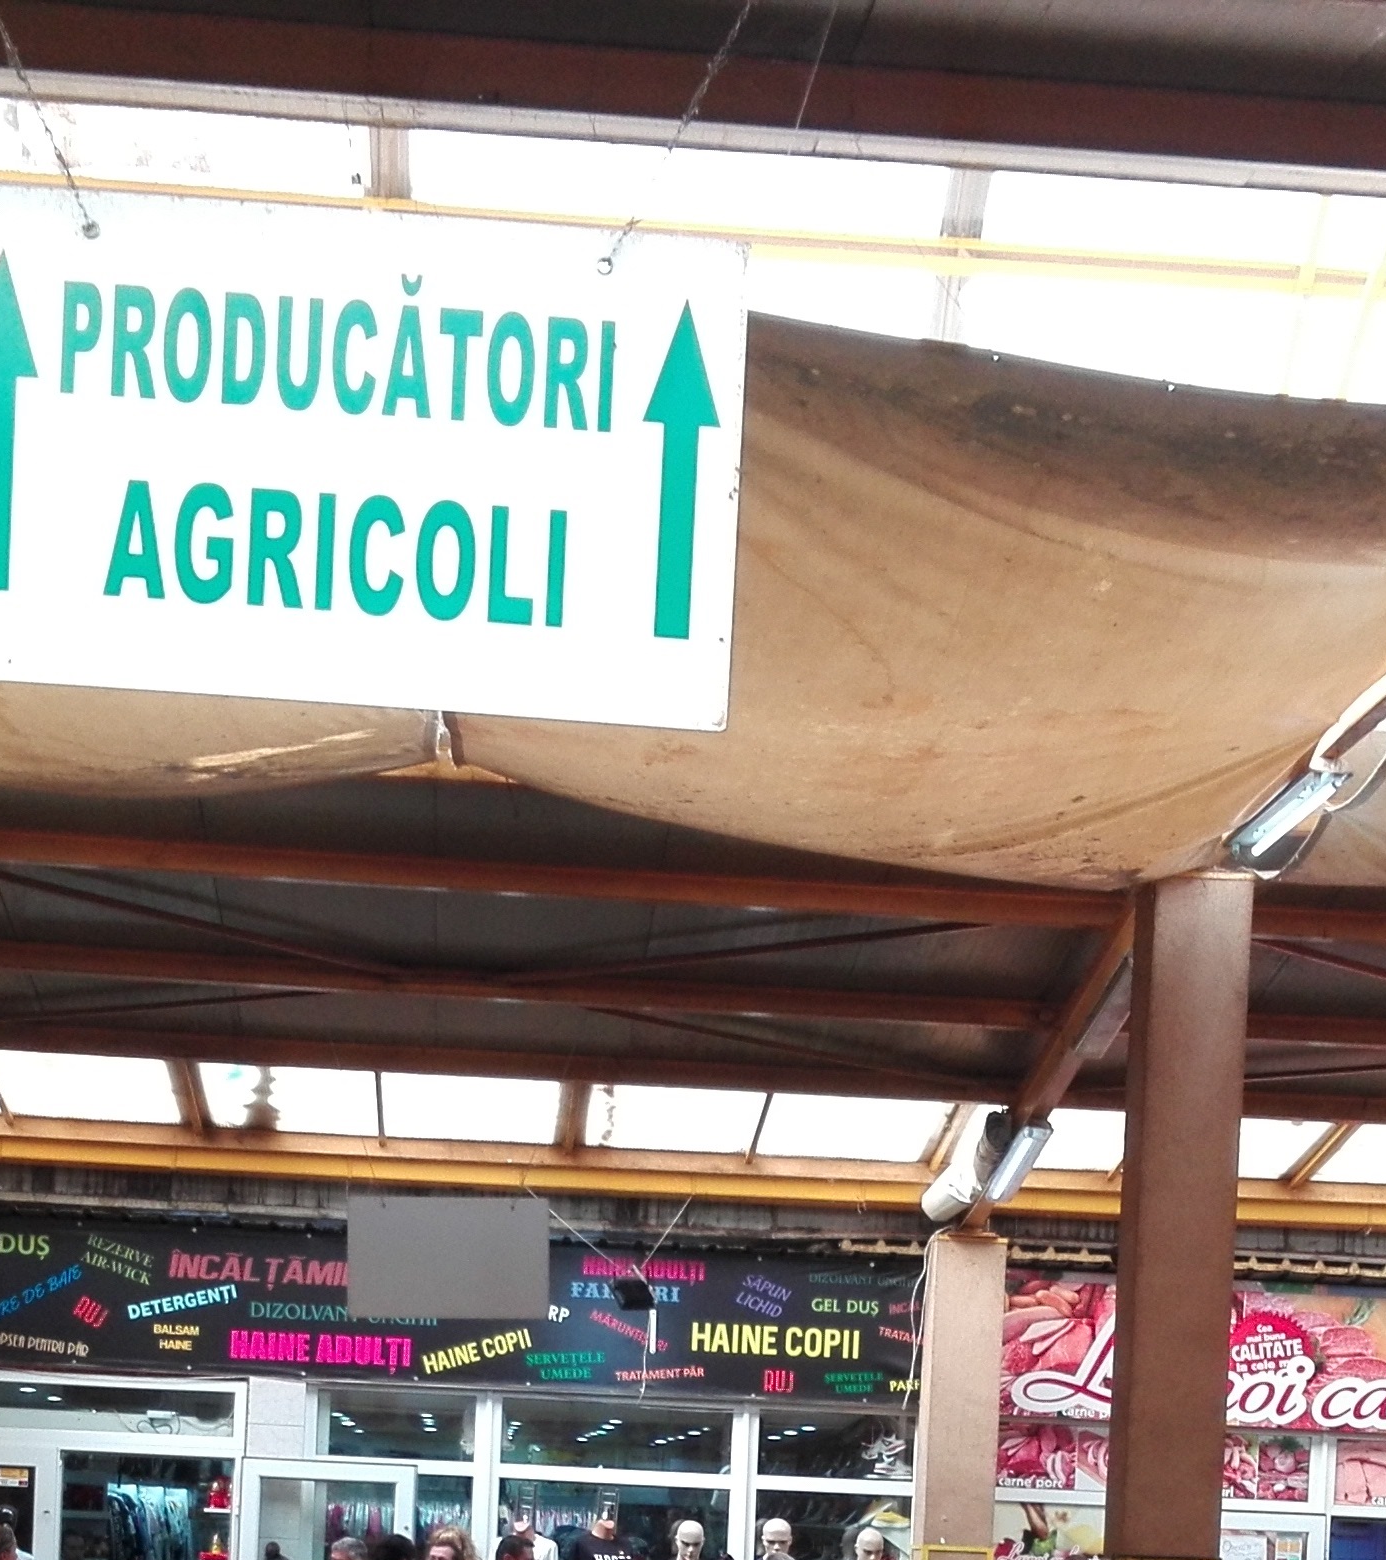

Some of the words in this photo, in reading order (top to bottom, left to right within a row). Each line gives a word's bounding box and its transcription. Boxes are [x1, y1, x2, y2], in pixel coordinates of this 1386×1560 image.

[59, 273, 616, 433] PRODUCĂTORI
[102, 479, 568, 628] AGRICOLI
[86, 1233, 155, 1268] REZERVE
[80, 1250, 151, 1287] AIR-WICK
[809, 1273, 873, 1286] DIZOLVANT
[21, 1282, 45, 1305] DE
[46, 1263, 83, 1293] BAIE
[742, 1273, 792, 1302] SĂPUN
[72, 1295, 110, 1329] RUJ
[127, 1283, 238, 1321] DETERGENȚI
[735, 1291, 783, 1319] LICHID
[811, 1298, 842, 1313] GEL
[846, 1299, 880, 1318] DUȘ
[153, 1323, 200, 1336] BALSAM
[691, 1321, 780, 1356] HAINE
[784, 1326, 861, 1360] COPII
[27, 1338, 66, 1354] PENTRU
[159, 1339, 193, 1351] HAINE
[228, 1330, 311, 1363] HAINE
[315, 1334, 412, 1375] ADULȚI
[422, 1340, 480, 1375] HAINE
[481, 1328, 533, 1359] COPII
[1231, 1338, 1304, 1363] CALITATE
[540, 1367, 593, 1381] UMEDE
[615, 1369, 681, 1382] TRATAMENT
[682, 1366, 705, 1379] PĂR
[763, 1368, 795, 1394] RUJ
[835, 1384, 873, 1394] UMEDE
[998, 1476, 1031, 1488] carne
